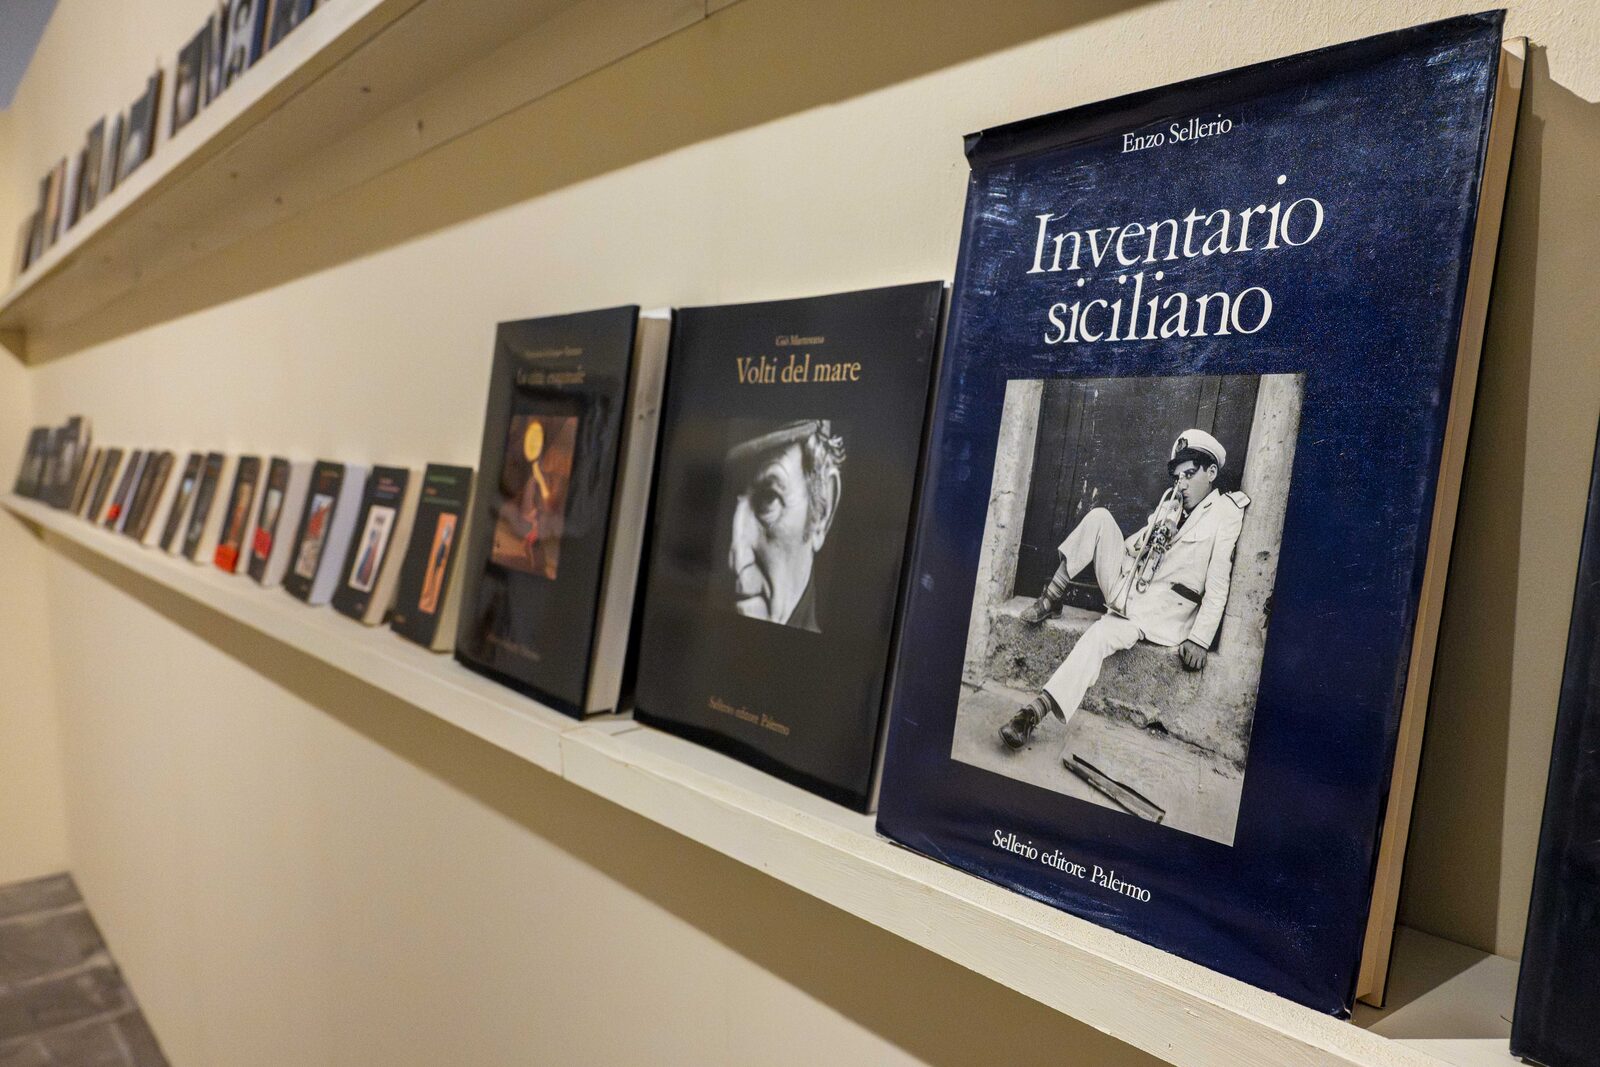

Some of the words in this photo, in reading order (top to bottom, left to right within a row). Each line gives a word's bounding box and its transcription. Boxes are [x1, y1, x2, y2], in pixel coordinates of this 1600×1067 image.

[1121, 130, 1165, 154] Enzo
[1169, 113, 1233, 144] Sellerio
[1026, 175, 1325, 275] Inventario
[1044, 270, 1273, 344] siciliano
[736, 356, 778, 385] Volti
[781, 353, 811, 383] del
[813, 360, 862, 383] mare
[992, 829, 1038, 860] Sellerio
[1041, 849, 1087, 879] editore
[1090, 865, 1151, 903] Palermo
